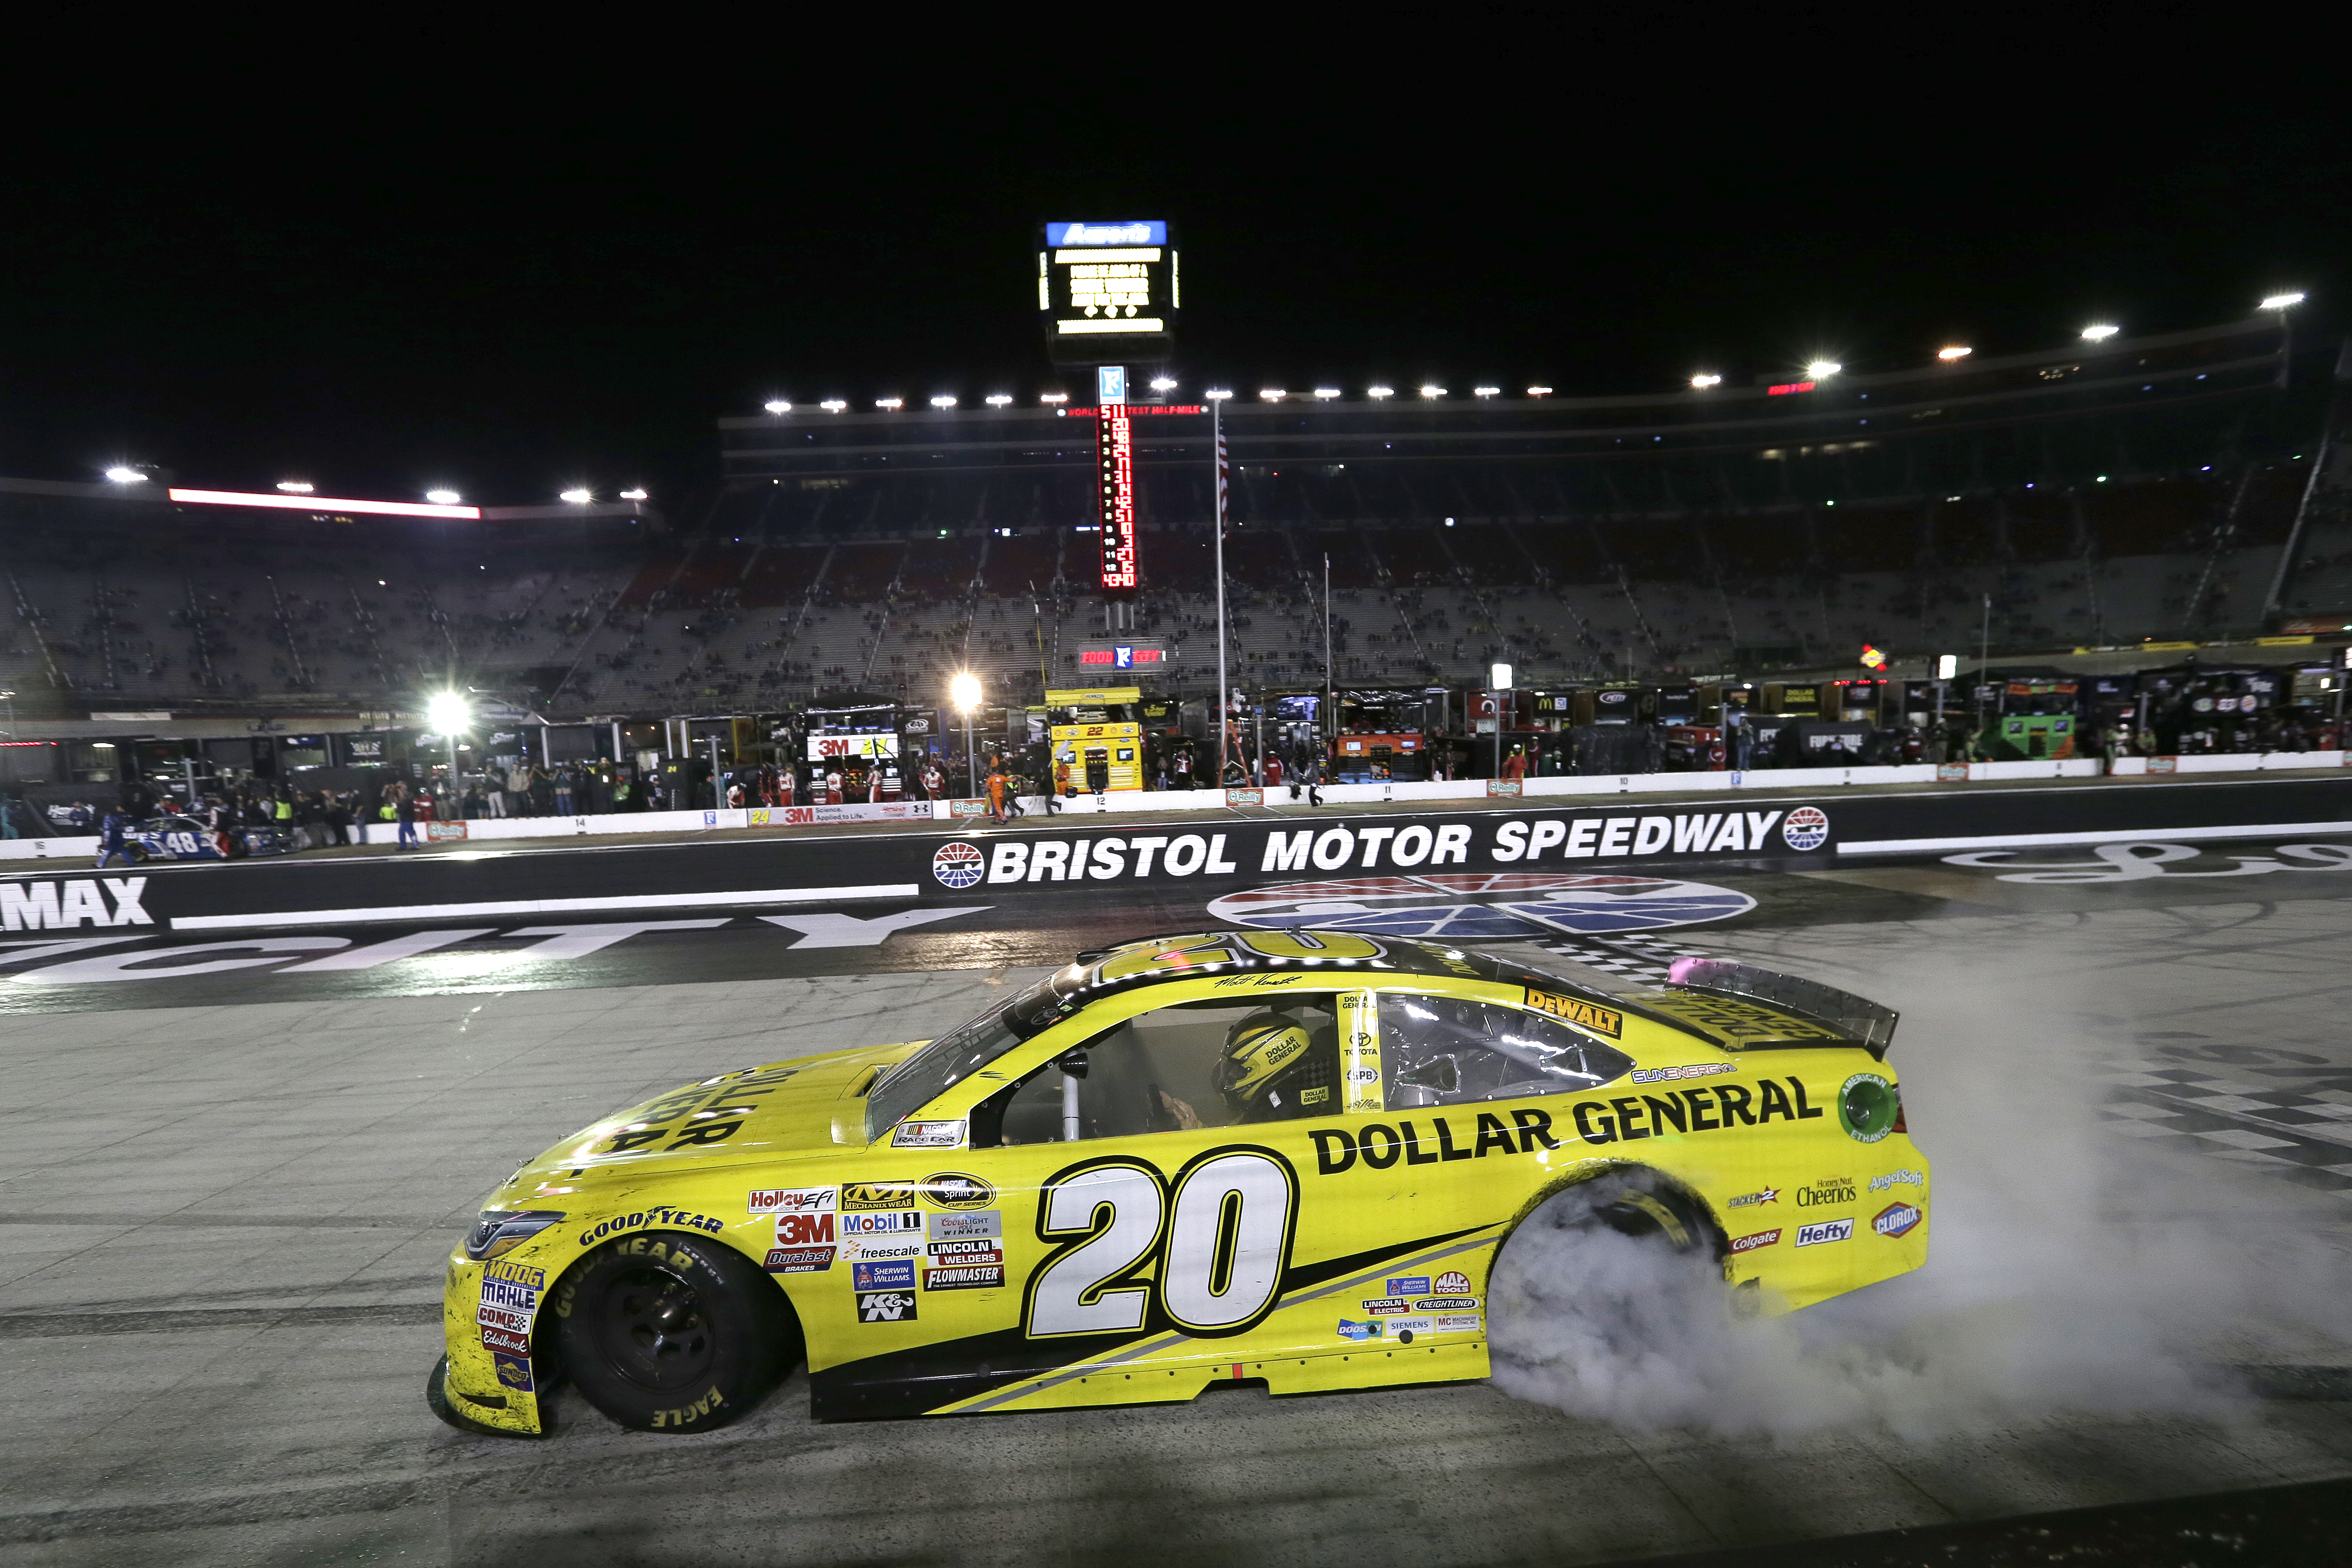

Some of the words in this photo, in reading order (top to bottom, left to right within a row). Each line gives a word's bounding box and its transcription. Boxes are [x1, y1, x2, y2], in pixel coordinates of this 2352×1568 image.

[1128, 406, 1150, 414] TEST
[1151, 405, 1200, 414] HALF-MILE
[1112, 418, 1130, 431] 20
[1102, 434, 1110, 442] 2
[1112, 431, 1130, 444] 48
[1103, 447, 1110, 455] 3
[1112, 444, 1130, 458] 24
[1113, 470, 1131, 484] 31
[1114, 496, 1132, 509] 42
[1115, 509, 1132, 522] 51
[1124, 535, 1133, 547] 3
[1116, 547, 1133, 561] 27
[1122, 561, 1134, 573] 6
[1082, 651, 1113, 663] FOOD
[1132, 650, 1159, 662] CITY
[1087, 726, 1103, 736] 22
[818, 740, 849, 755] 3M
[1488, 780, 1521, 794] O'Reilly
[1620, 777, 1628, 785] 10
[1384, 785, 1391, 794] 11
[1097, 797, 1106, 805] 12
[1227, 791, 1261, 803] O'Reilly
[952, 801, 986, 815] O'Reilly
[576, 818, 586, 827] 14
[751, 809, 770, 824] 24
[785, 808, 813, 823] 3M
[165, 832, 199, 854] 48
[987, 834, 1237, 884] BRISTOL
[1261, 824, 1473, 872] MOTOR
[1491, 810, 1784, 862] SPEEDWAY
[0, 877, 154, 931] MAX
[1265, 1036, 1297, 1059] DOLLAR
[1268, 1041, 1302, 1066] GENERAL
[1631, 1062, 1738, 1084] SUNENERGY1
[1842, 1073, 1887, 1096] AMERICAN
[1303, 1094, 1327, 1102] GENERAL
[922, 1125, 953, 1135] NASCA
[1309, 1107, 1560, 1175] DOLLAR
[1571, 1076, 1823, 1145] GENERAL
[1850, 1123, 1892, 1143] ETHANOL
[1817, 1178, 1839, 1188] Honey
[1839, 1177, 1853, 1186] Nut
[1868, 1169, 1903, 1193] Angel
[1901, 1168, 1924, 1187] Soft
[750, 1191, 804, 1210] Holley
[798, 1190, 834, 1209] EFI
[944, 1189, 971, 1200] Sprint
[1728, 1193, 1761, 1209] STACKER
[1761, 1190, 1775, 1201] 2
[1797, 1186, 1857, 1207] Cheerios
[844, 1201, 887, 1210] MECHANIX
[887, 1199, 913, 1207] WEAR
[844, 1213, 898, 1231] Mobil
[941, 1217, 965, 1226] Coors
[1876, 1205, 1919, 1236] CLOROX
[777, 1213, 834, 1246] 3M
[1799, 1222, 1851, 1244] Hefty
[930, 1241, 989, 1255] LINCOLN
[1024, 1144, 1301, 1340] 20
[1732, 1231, 1777, 1251] Colgate
[767, 1249, 832, 1265] Duralast
[861, 1245, 920, 1259] freescale
[944, 1253, 996, 1264] WELDERS
[484, 1259, 543, 1286] MOOG
[874, 1267, 909, 1275] SHERWIN
[874, 1274, 910, 1282] WILLIAMS
[927, 1267, 999, 1289] FLOWMASTER
[1435, 1272, 1469, 1287] MAC
[481, 1281, 535, 1309] MAHLE
[1364, 1299, 1402, 1308] LINCOLN
[1419, 1300, 1473, 1309] FREIGHTLINER
[479, 1308, 516, 1326] COMP
[1438, 1317, 1451, 1326] MC
[1338, 1323, 1382, 1334] DOOSN
[1391, 1321, 1428, 1330] SIEMENS
[483, 1330, 527, 1353] Edelbrock
[497, 1365, 529, 1381] SUNOCO
[651, 1384, 724, 1428] EAGLE
